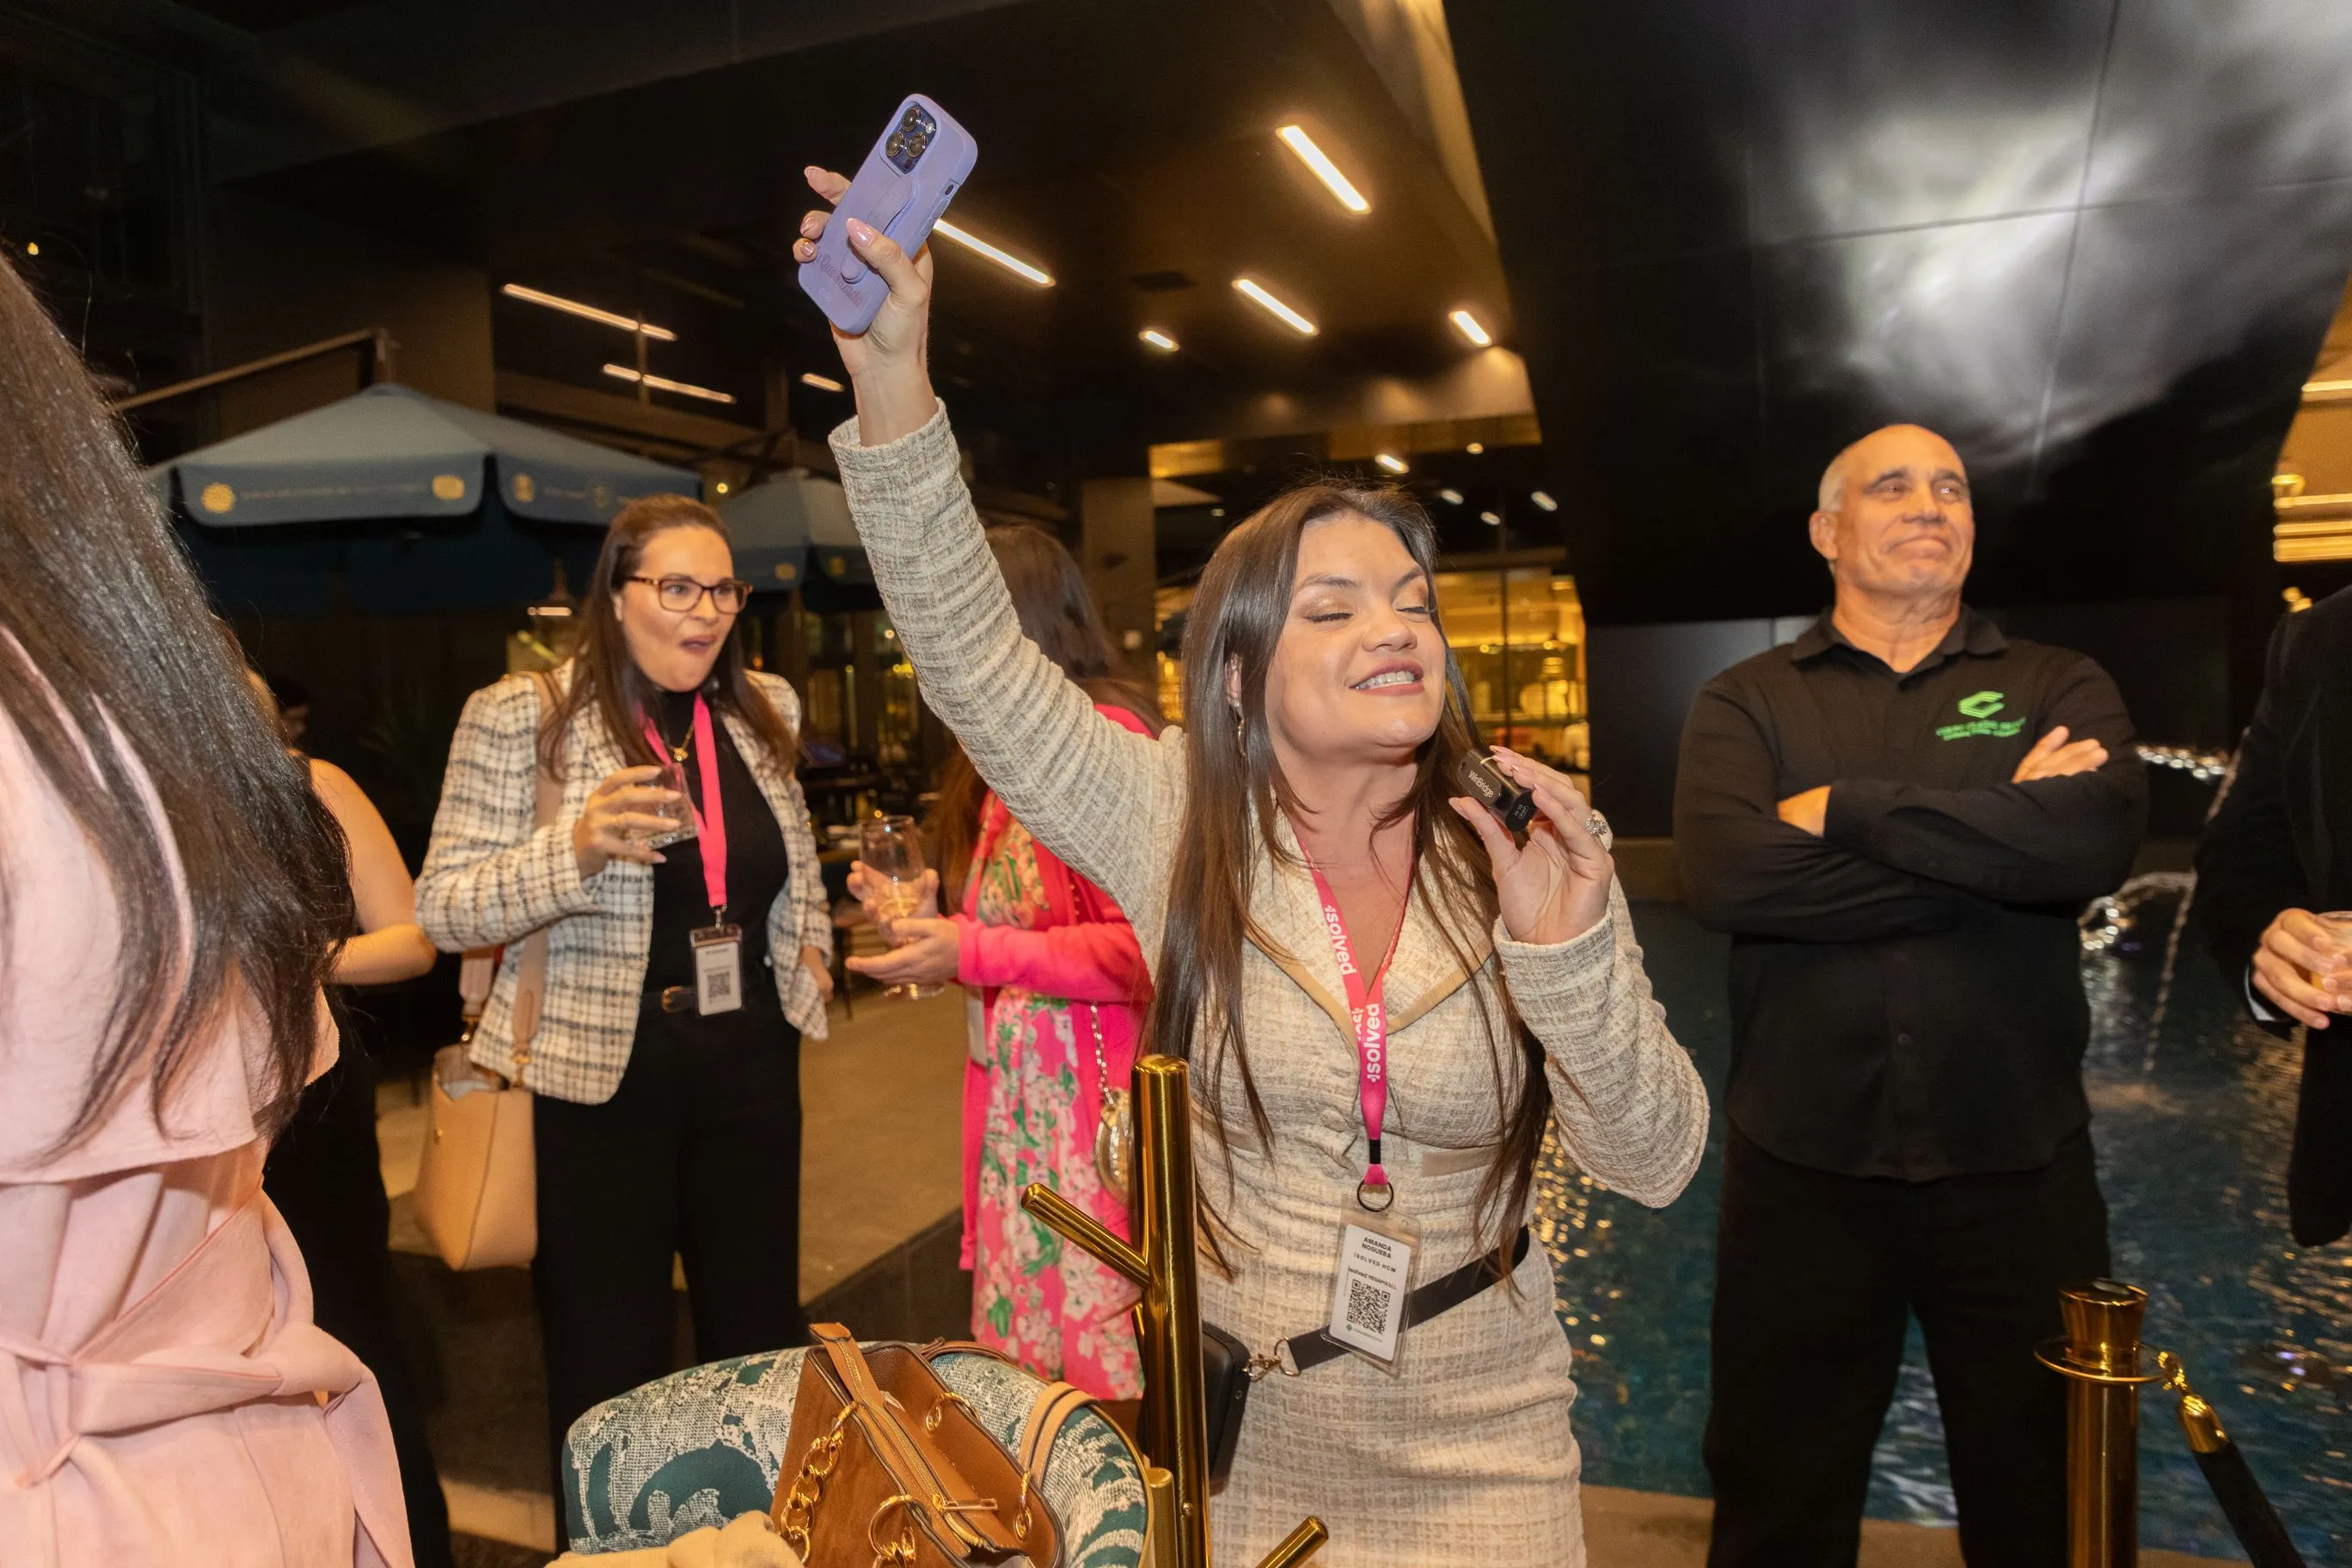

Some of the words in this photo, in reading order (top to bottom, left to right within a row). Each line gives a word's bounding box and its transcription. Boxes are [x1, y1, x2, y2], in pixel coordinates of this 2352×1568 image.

[1468, 769, 1494, 798] WinBridge
[1361, 1242, 1392, 1259] NOGUERA
[1363, 1237, 1392, 1252] AMANDA
